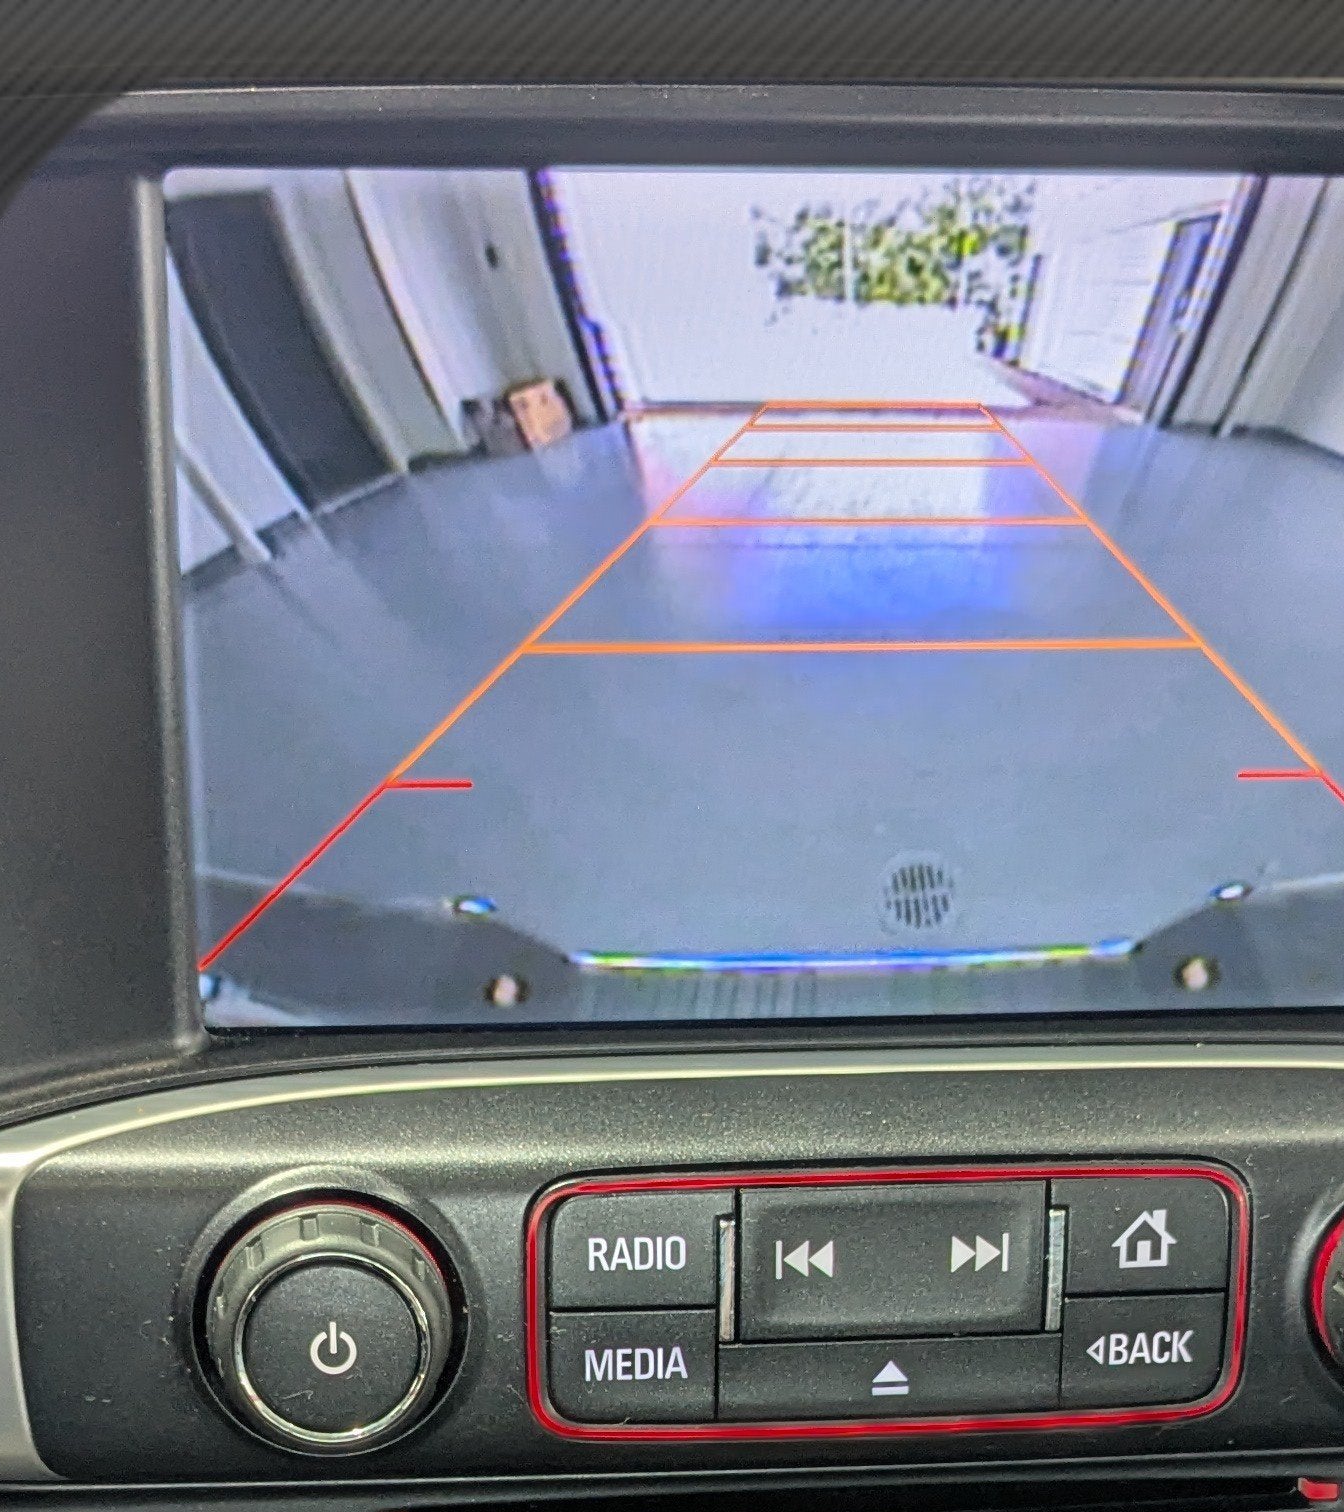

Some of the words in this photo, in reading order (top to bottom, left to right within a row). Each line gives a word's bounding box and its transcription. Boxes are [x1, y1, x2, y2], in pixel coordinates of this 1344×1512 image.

[586, 1234, 687, 1273] RADIO
[583, 1345, 690, 1383] MEDIA
[1108, 1329, 1194, 1366] BACK
